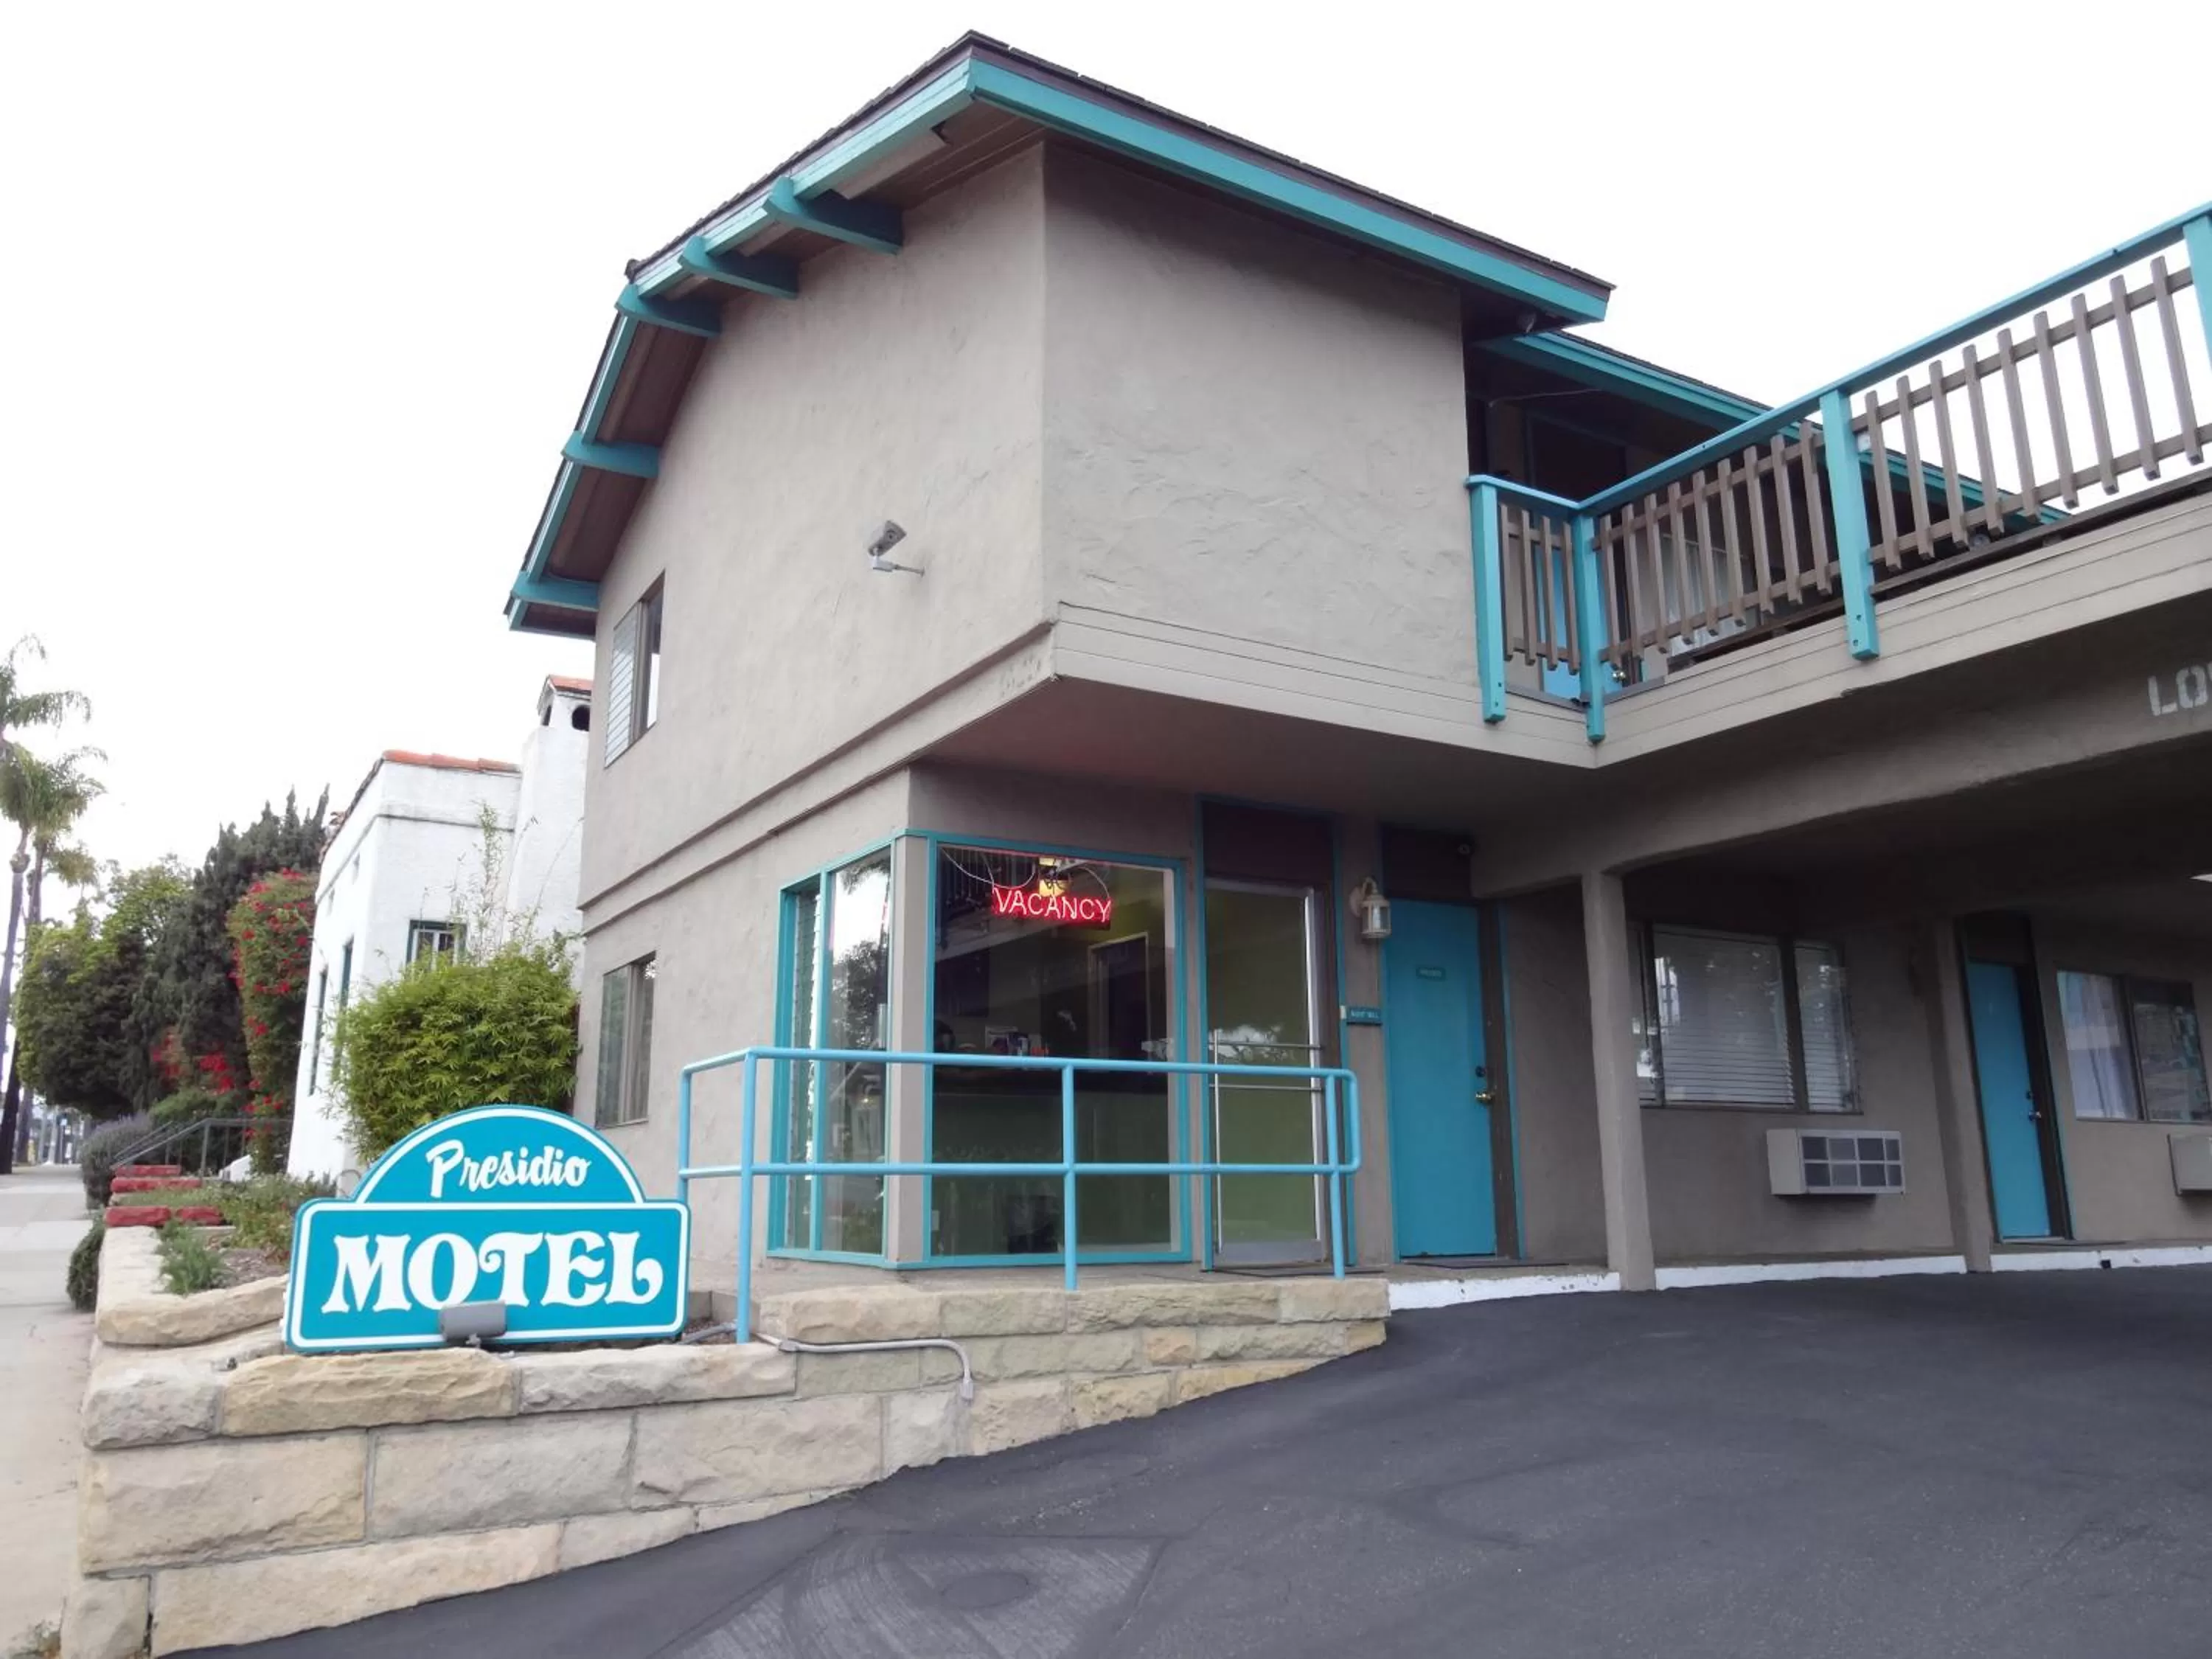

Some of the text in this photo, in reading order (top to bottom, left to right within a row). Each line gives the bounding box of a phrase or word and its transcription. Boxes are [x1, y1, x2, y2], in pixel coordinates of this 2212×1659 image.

[2148, 661, 2212, 716] LO
[992, 888, 1112, 922] VACANCY
[425, 1139, 591, 1198] Presidio
[321, 1231, 662, 1314] MOTEL
